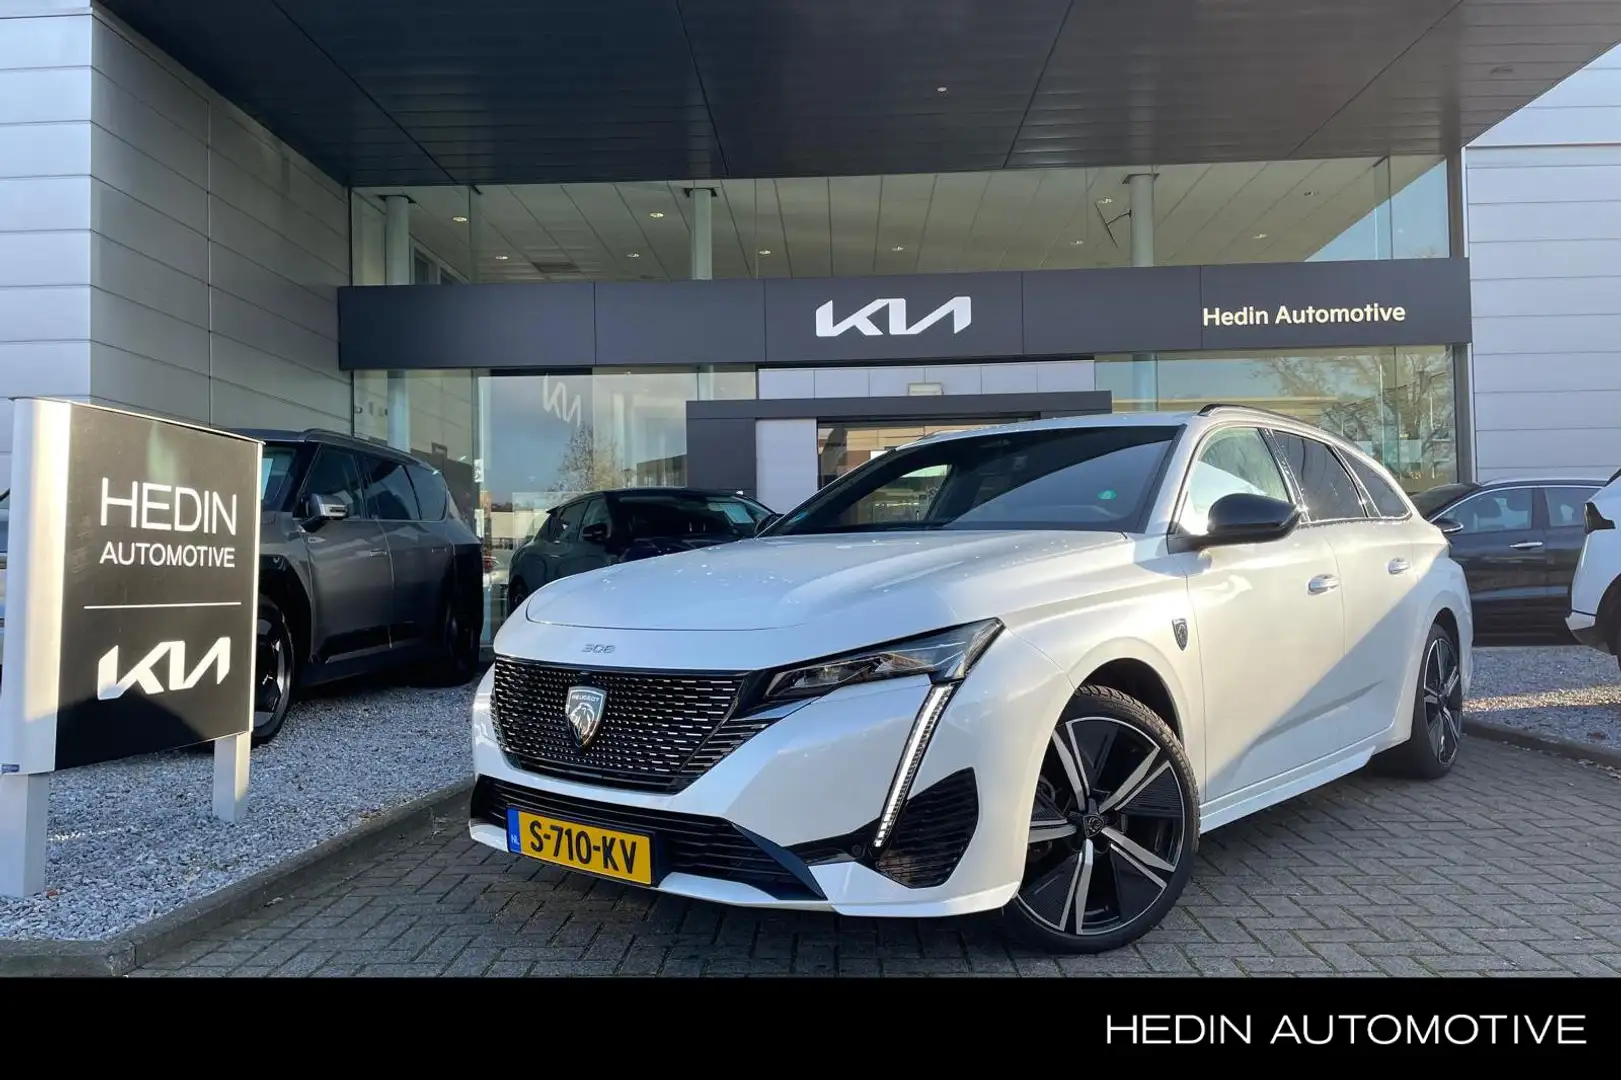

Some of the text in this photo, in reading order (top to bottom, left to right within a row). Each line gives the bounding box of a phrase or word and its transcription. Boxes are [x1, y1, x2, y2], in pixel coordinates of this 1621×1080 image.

[815, 296, 972, 338] KIA
[1202, 302, 1406, 327] Hedin Automotive
[100, 477, 238, 536] HEDIN
[99, 541, 236, 569] AUTOMOTIVE
[97, 636, 232, 701] KIA
[571, 694, 600, 702] PEUGEOT
[510, 820, 637, 874] NL S-710-KV
